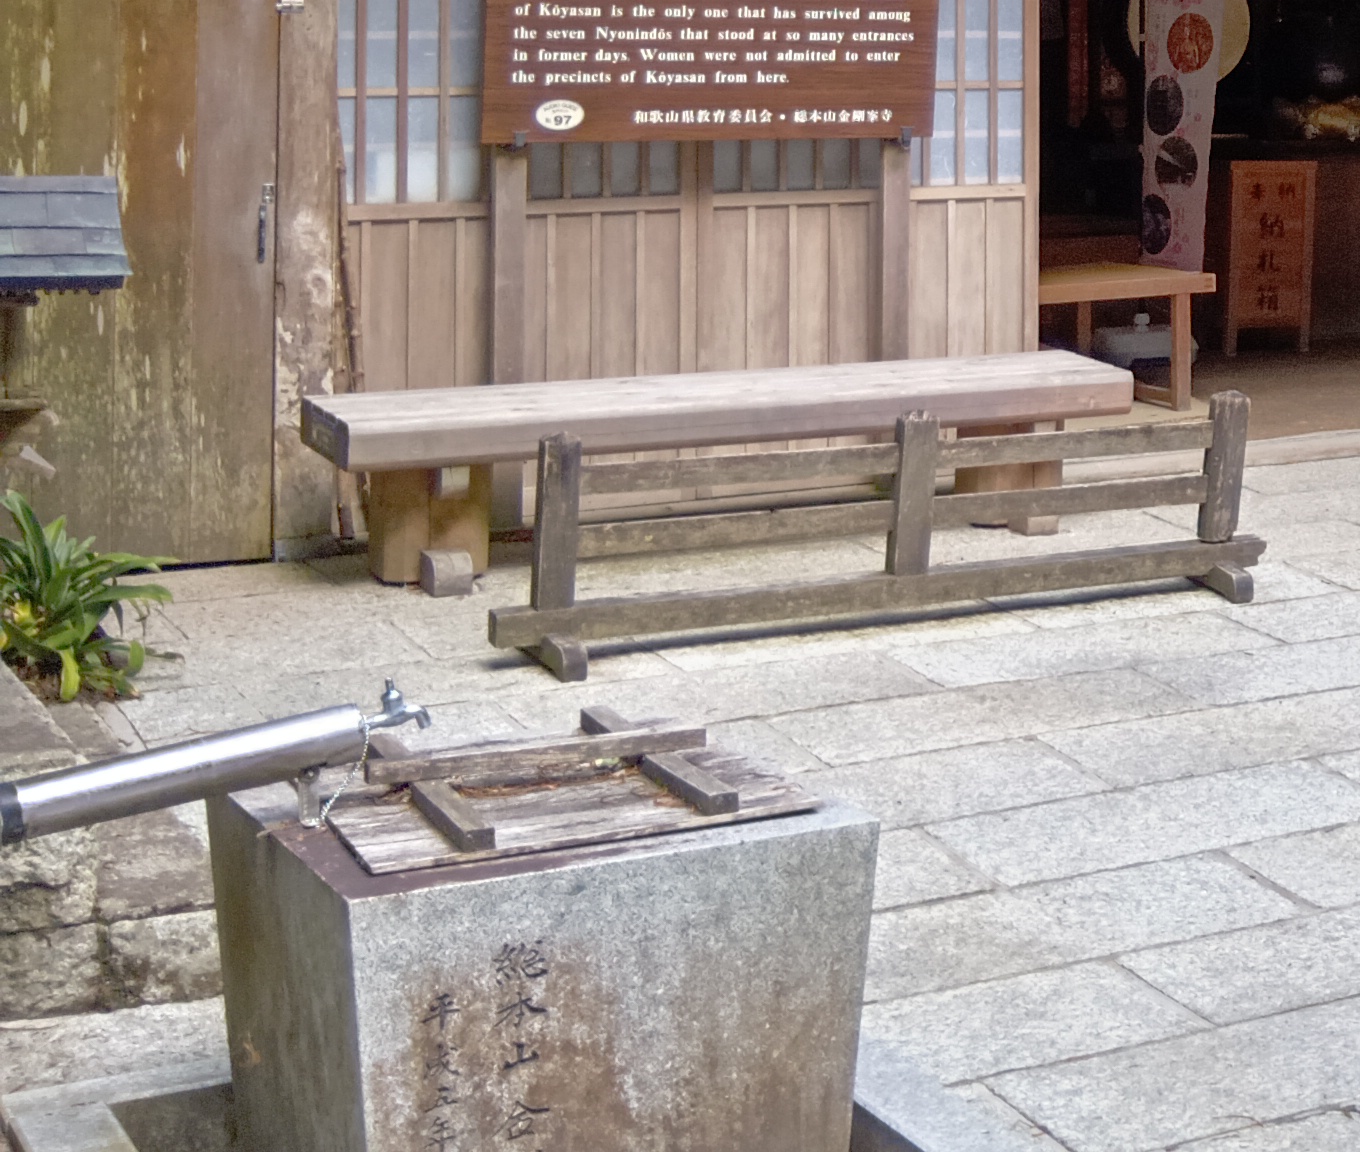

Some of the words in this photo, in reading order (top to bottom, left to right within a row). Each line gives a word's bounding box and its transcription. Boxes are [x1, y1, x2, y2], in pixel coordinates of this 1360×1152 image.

[513, 3, 531, 17] of
[610, 4, 623, 17] is
[632, 4, 656, 18] the
[663, 4, 696, 21] only
[703, 8, 729, 19] one
[737, 5, 766, 19] that
[773, 5, 797, 20] has
[804, 7, 860, 20] survived
[868, 10, 911, 23] among
[513, 25, 537, 40] the
[545, 29, 586, 40] seven
[680, 27, 709, 41] that
[717, 27, 755, 41] stood
[762, 30, 777, 41] at
[785, 31, 801, 41] so
[808, 31, 845, 44] many
[851, 31, 915, 42] entrances
[512, 48, 528, 62] in
[537, 48, 588, 62] former
[639, 48, 695, 62] Women
[704, 51, 737, 62] were
[745, 50, 768, 62] not
[776, 48, 837, 62] admitted
[844, 50, 859, 62] to
[865, 50, 901, 63] enter
[511, 69, 535, 84] the
[544, 70, 612, 86] precincts
[619, 70, 637, 84] of
[714, 70, 748, 84] from
[553, 114, 573, 127] 97
